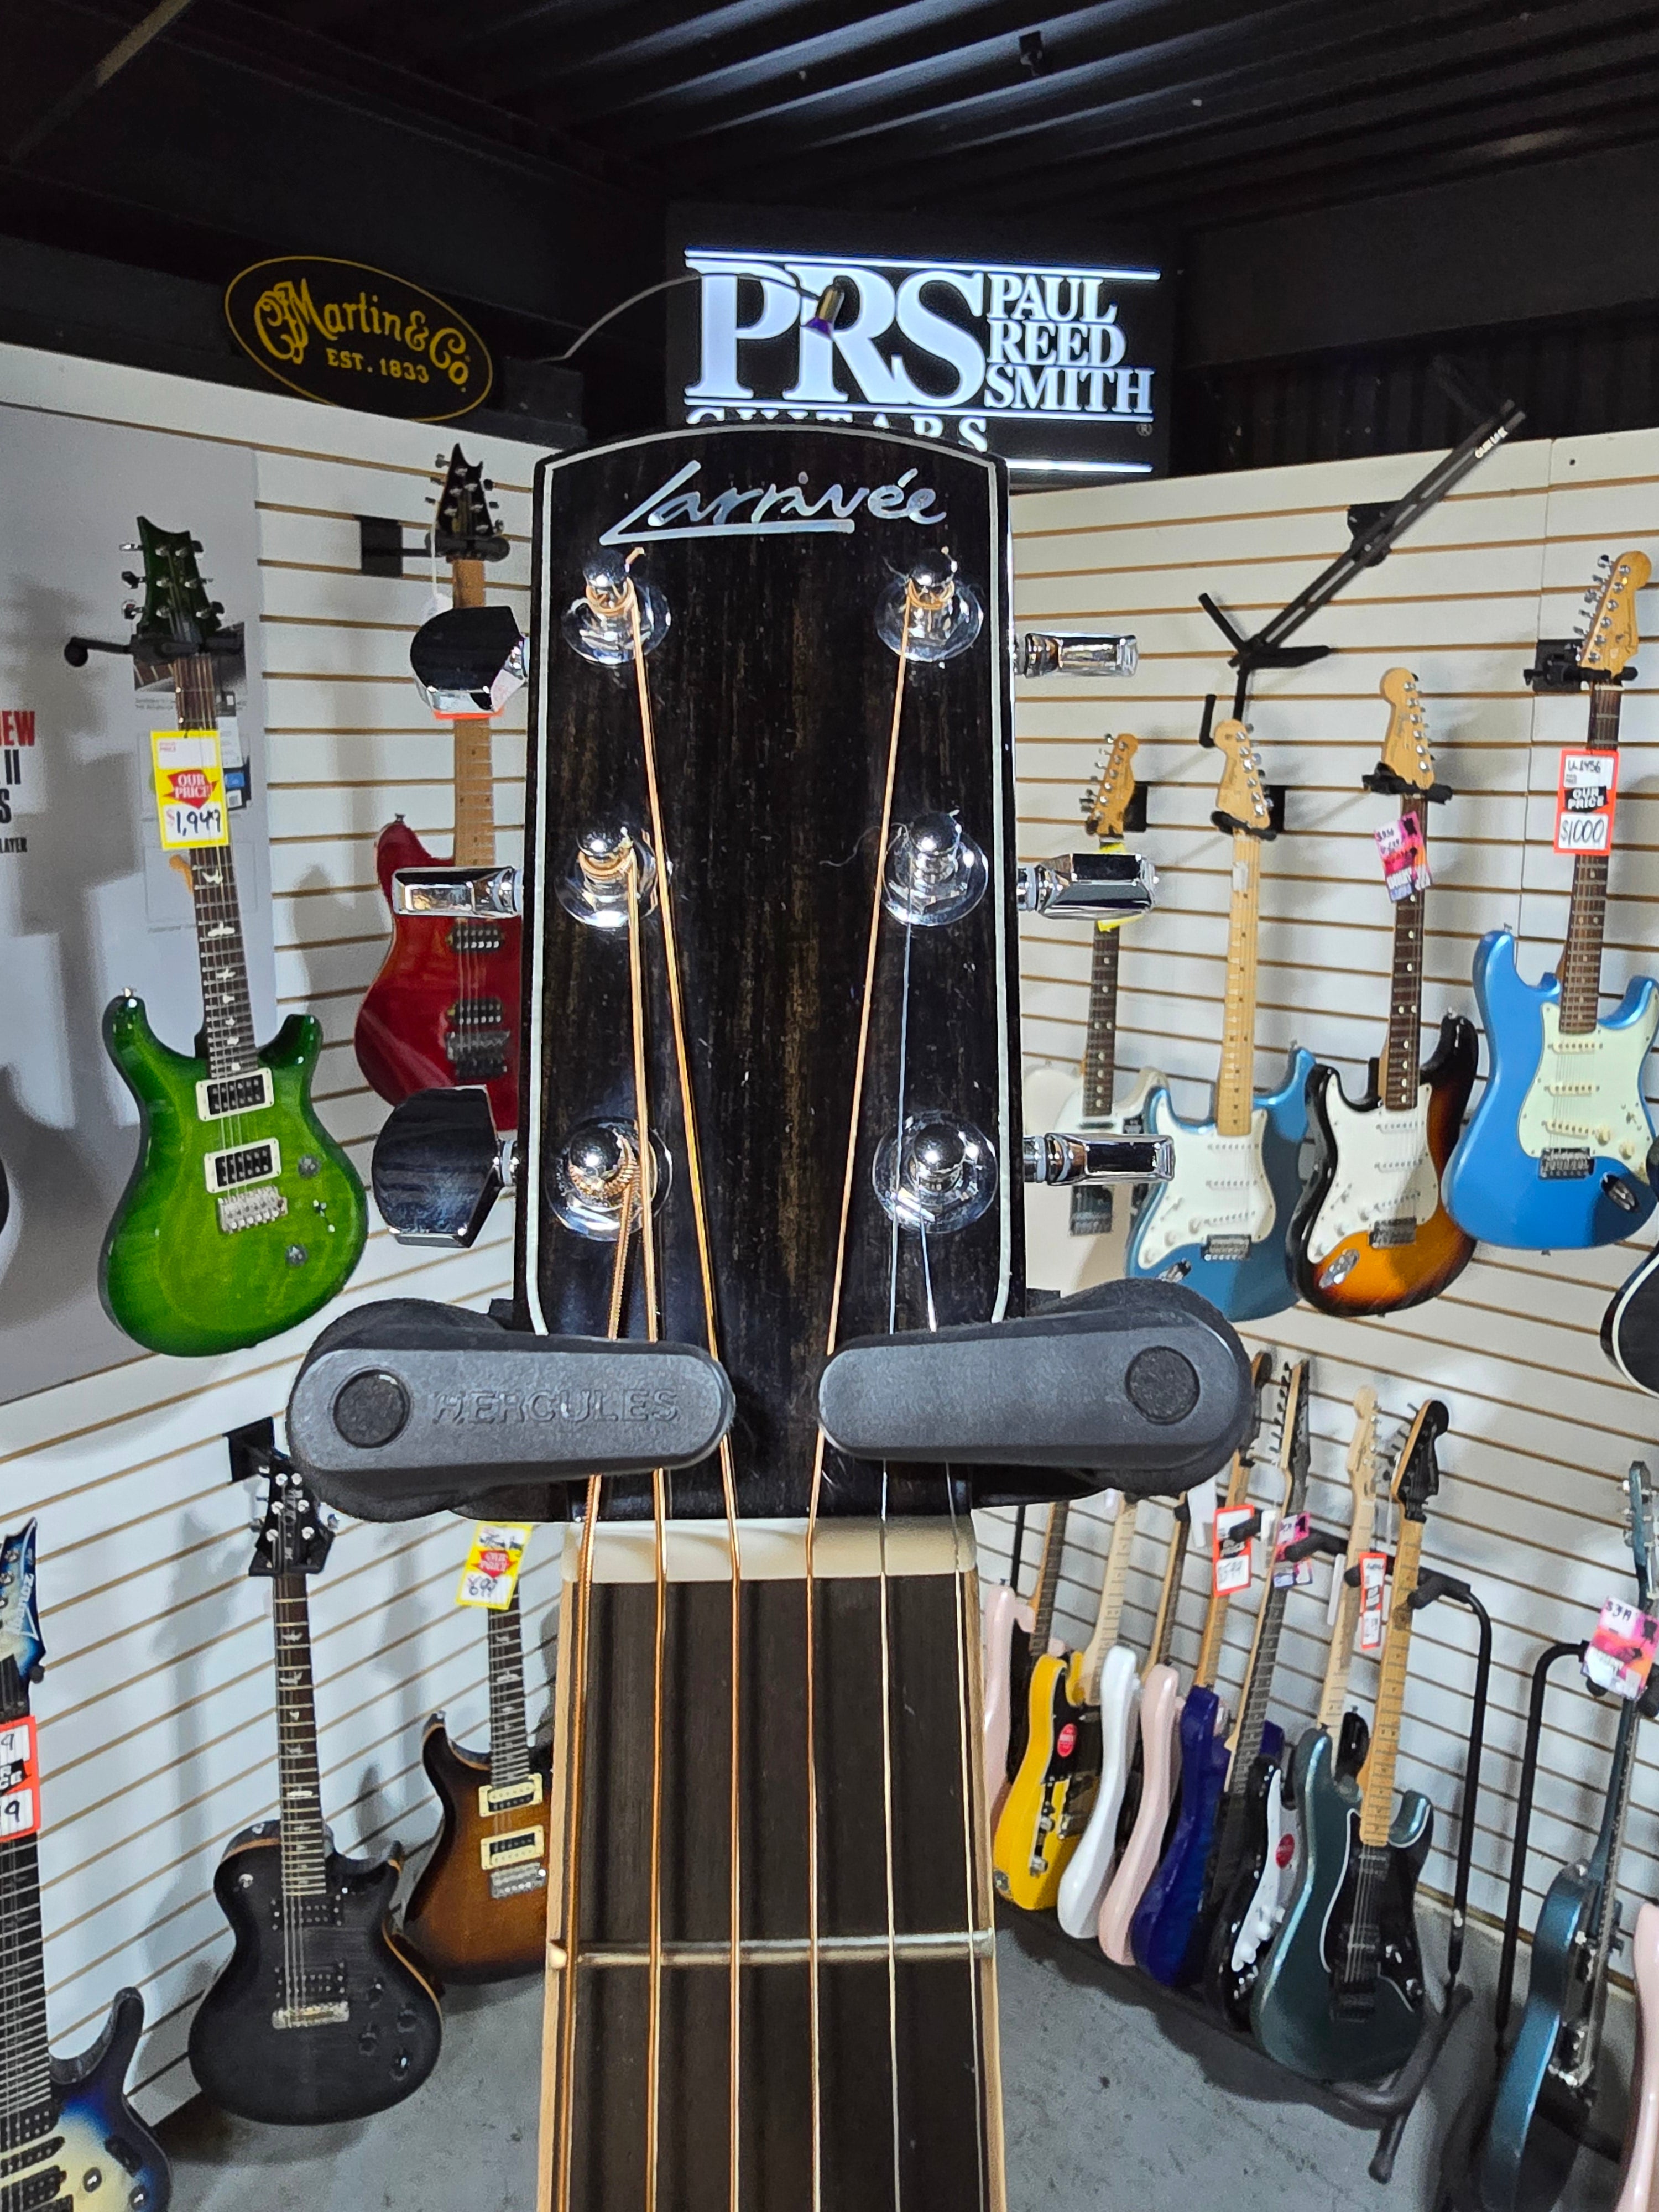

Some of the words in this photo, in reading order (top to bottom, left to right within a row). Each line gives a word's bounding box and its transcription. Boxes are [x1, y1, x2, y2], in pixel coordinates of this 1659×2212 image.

[987, 272, 1118, 324] PAUL
[684, 258, 986, 407] PRS
[987, 320, 1126, 366] REED
[326, 348, 373, 373] EST.
[380, 358, 430, 384] 1833
[984, 363, 1155, 414] SMITH
[599, 460, 947, 546] Larrivée
[177, 773, 206, 786] OUR
[1573, 787, 1599, 800] OUR
[1568, 795, 1604, 810] PRICE
[1560, 818, 1604, 846] $1000
[431, 1389, 681, 1425] HERCULES
